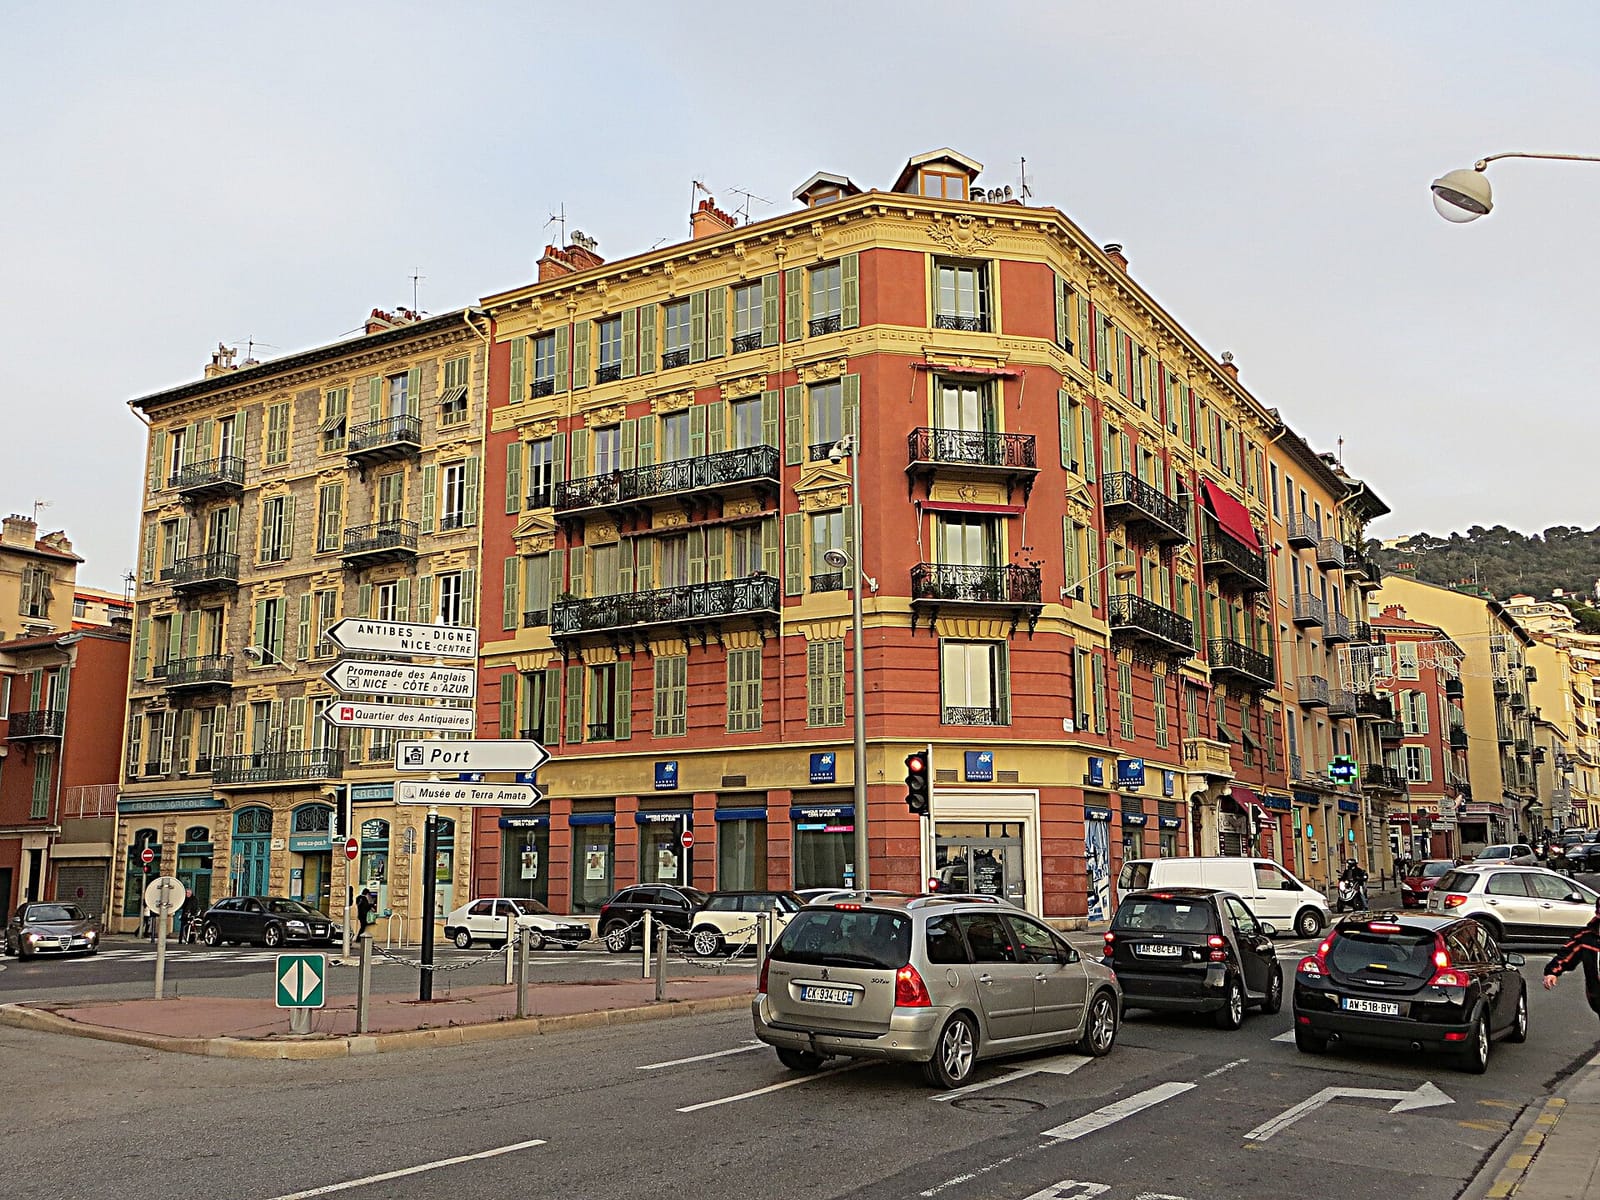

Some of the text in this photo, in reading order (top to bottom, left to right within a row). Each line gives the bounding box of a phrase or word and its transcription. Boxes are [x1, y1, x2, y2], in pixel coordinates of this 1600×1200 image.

[357, 624, 413, 638] ANTIBES
[433, 630, 473, 643] DIGNE
[346, 665, 467, 684] Promenade des Anglais
[362, 679, 388, 690] NICE
[402, 677, 429, 691] CÔTE
[354, 709, 470, 726] Quartier des Antiquaires
[430, 748, 470, 763] Port
[418, 787, 527, 801] Musée de Terra Amata
[165, 799, 206, 810] AGRICOLE
[806, 987, 848, 1004] CK-934-LC
[1349, 999, 1393, 1014] AW-518-BY
